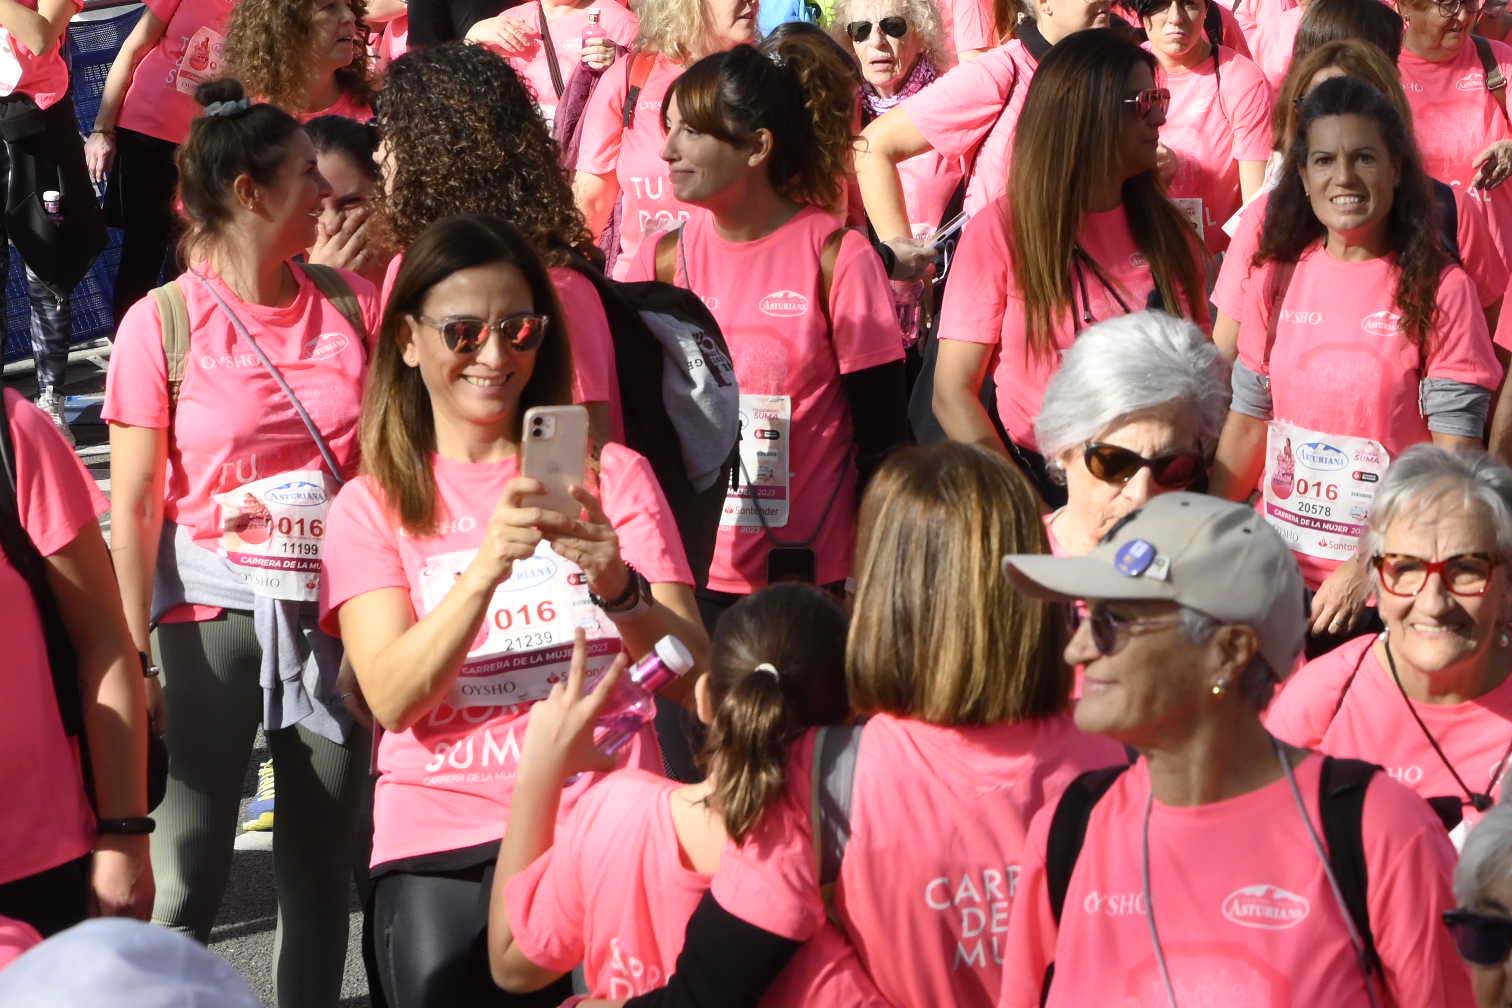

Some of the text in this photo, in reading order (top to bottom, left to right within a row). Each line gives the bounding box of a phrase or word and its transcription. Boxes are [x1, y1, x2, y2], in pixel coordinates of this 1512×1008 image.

[630, 176, 663, 200] TU
[221, 454, 257, 485] TU
[1296, 478, 1339, 501] 016
[735, 505, 779, 517] Santander
[1298, 502, 1331, 517] 20578
[277, 517, 324, 538] 016
[1273, 508, 1361, 535] CARRERA DE LA MUJER 20
[282, 542, 318, 555] 11199
[1329, 539, 1359, 552] Santan
[240, 556, 321, 570] CARRERA DE LA MU
[494, 600, 556, 630] 016
[505, 631, 553, 652] 21239
[461, 660, 511, 675] CARRERA
[513, 657, 529, 667] DE
[530, 655, 544, 664] LA
[546, 648, 573, 662] MUJE
[461, 682, 516, 696] OYSHO
[424, 727, 520, 772] SUM
[925, 864, 1022, 910] CARR
[1229, 896, 1305, 919] ASTURIANA
[962, 902, 1009, 938] DE
[955, 941, 1003, 970] MU
